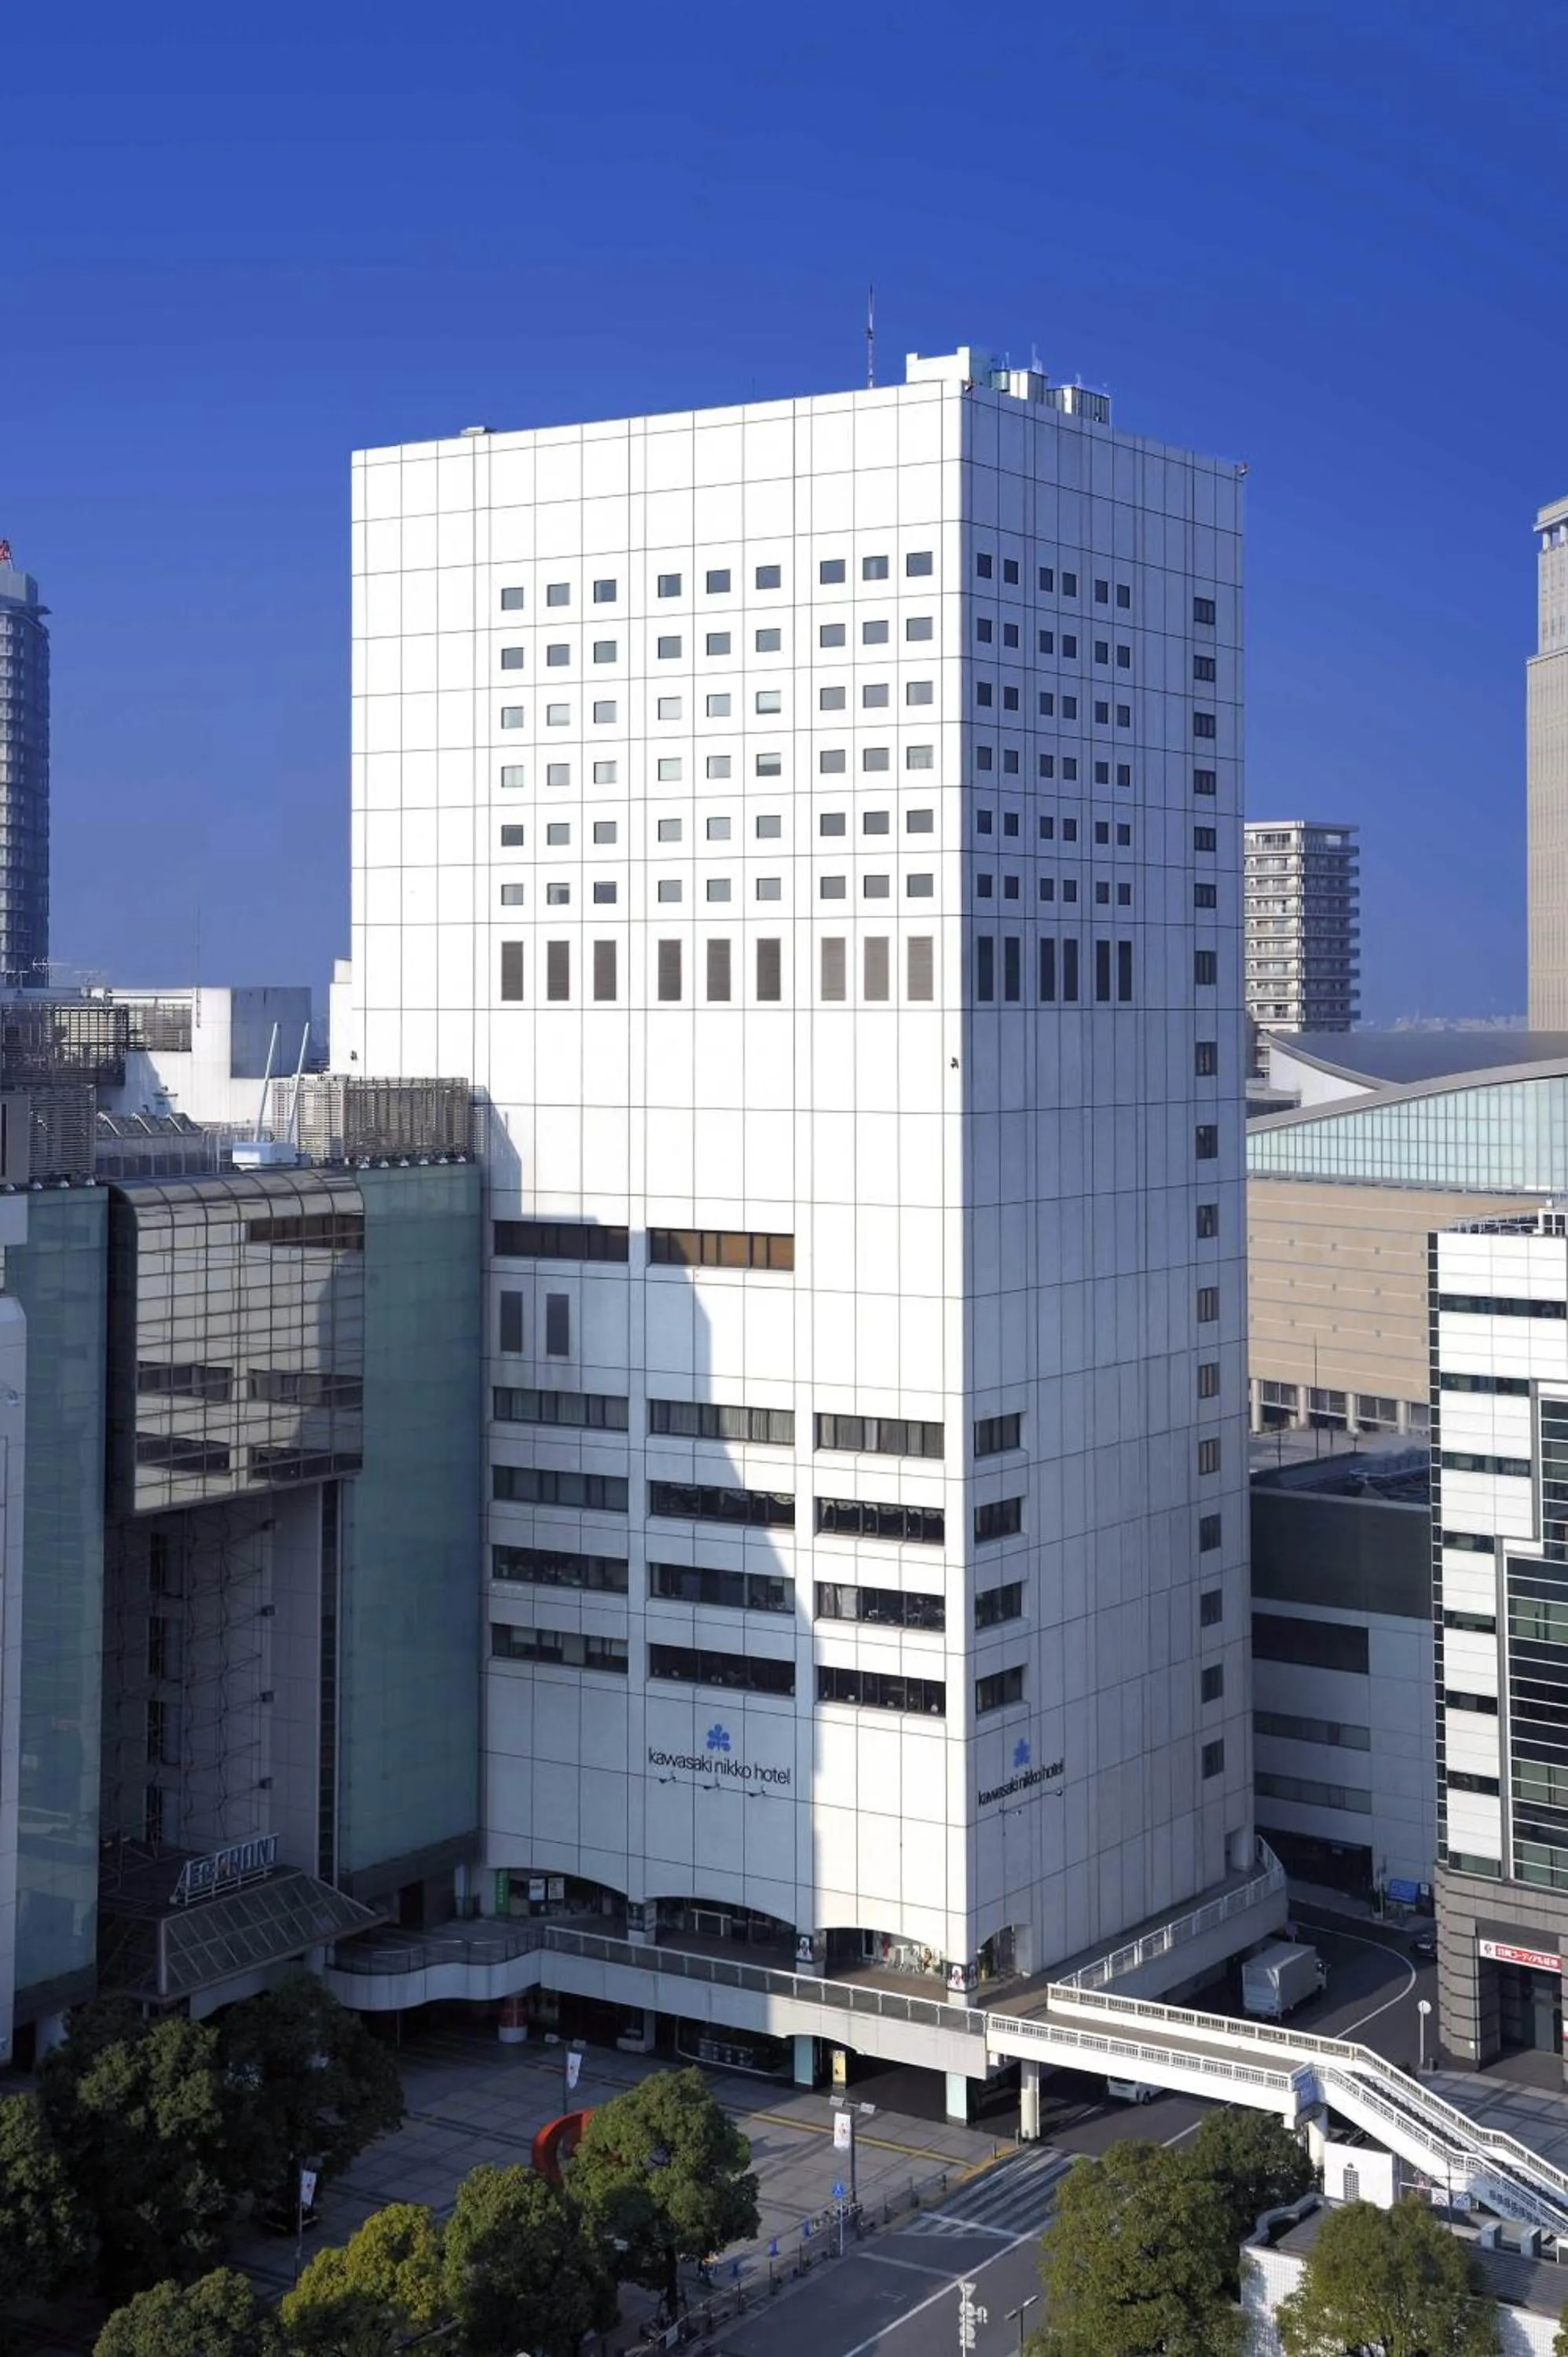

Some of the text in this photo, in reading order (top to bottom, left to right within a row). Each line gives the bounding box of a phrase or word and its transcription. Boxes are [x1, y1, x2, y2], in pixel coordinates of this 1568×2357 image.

[648, 1747, 790, 1784] kawasaki nikko hotel
[979, 1774, 1018, 1807] kawasaki
